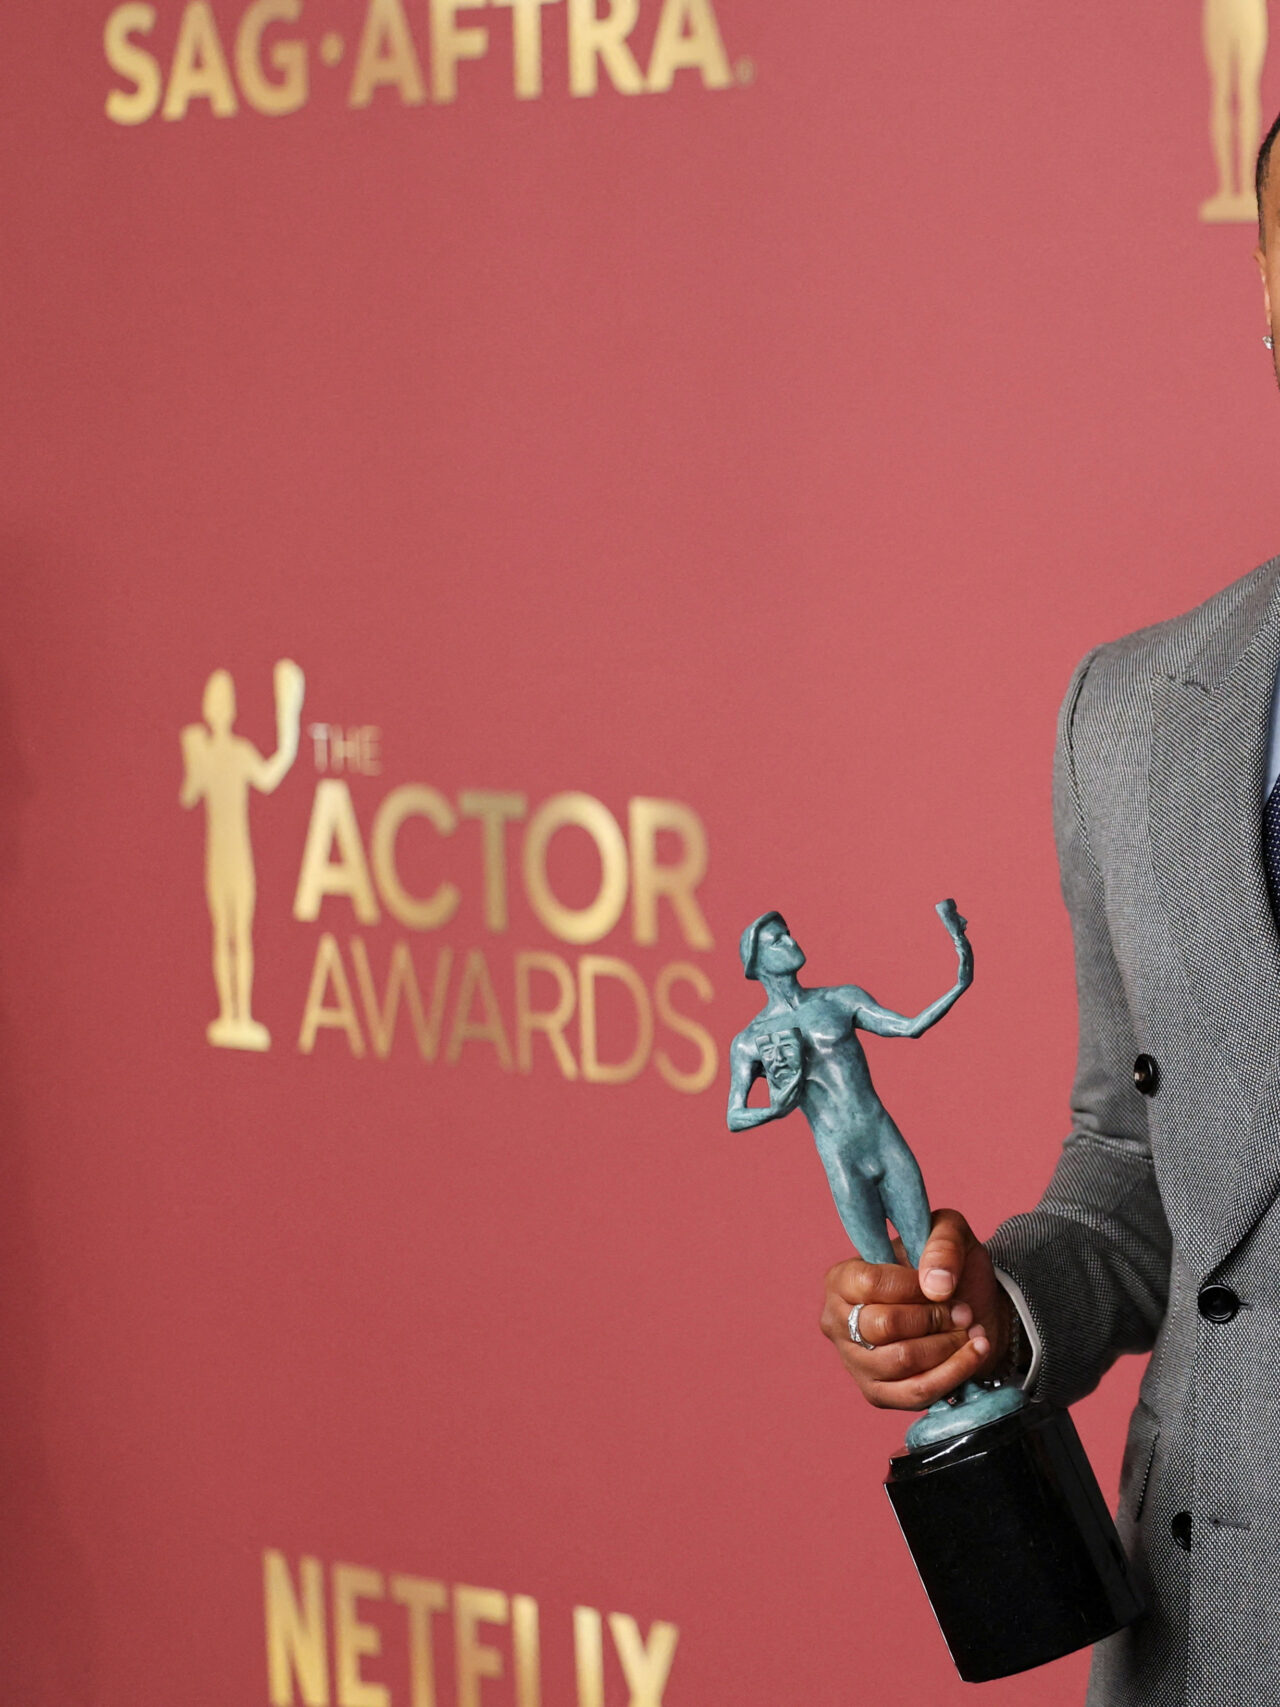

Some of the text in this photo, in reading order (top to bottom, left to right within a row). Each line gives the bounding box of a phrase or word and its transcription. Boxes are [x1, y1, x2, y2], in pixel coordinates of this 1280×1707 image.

[308, 722, 382, 776] THE
[293, 777, 715, 952] ACTOR
[298, 931, 720, 1095] AWARDS
